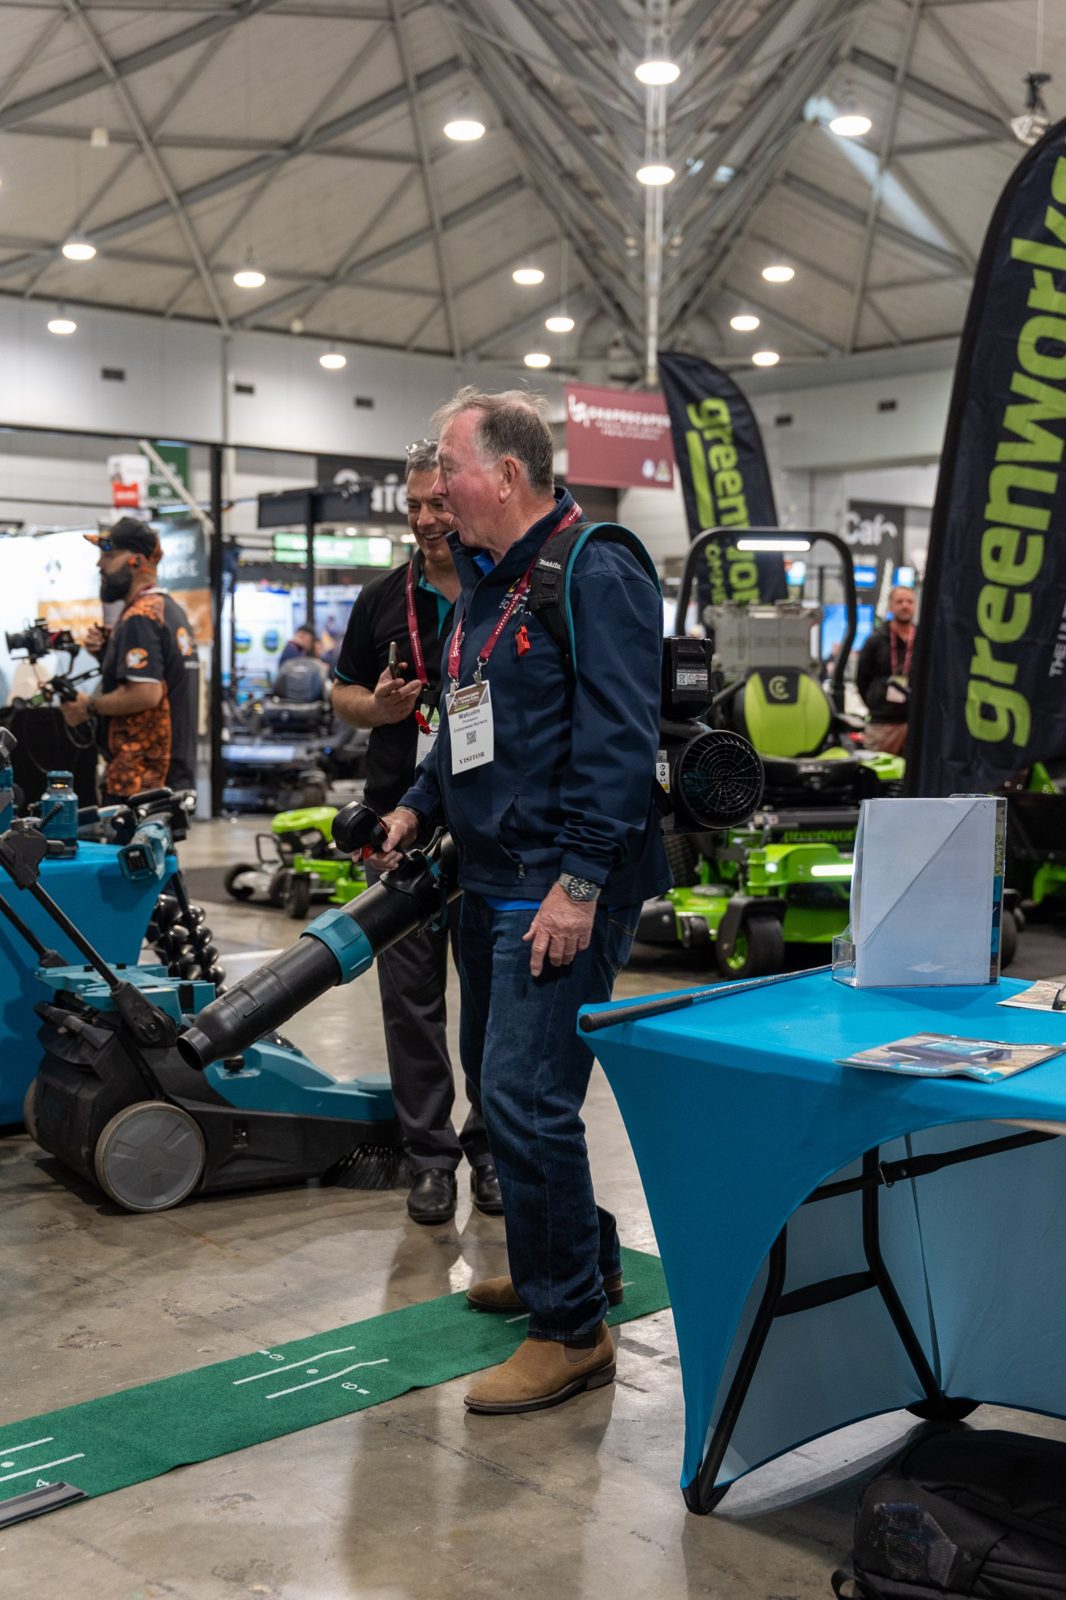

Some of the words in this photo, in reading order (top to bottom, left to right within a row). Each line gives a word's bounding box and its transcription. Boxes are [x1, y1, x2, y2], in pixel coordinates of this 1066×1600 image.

[965, 137, 1066, 747] greenwork
[459, 751, 485, 765] VISITOR
[36, 1478, 50, 1488] 4
